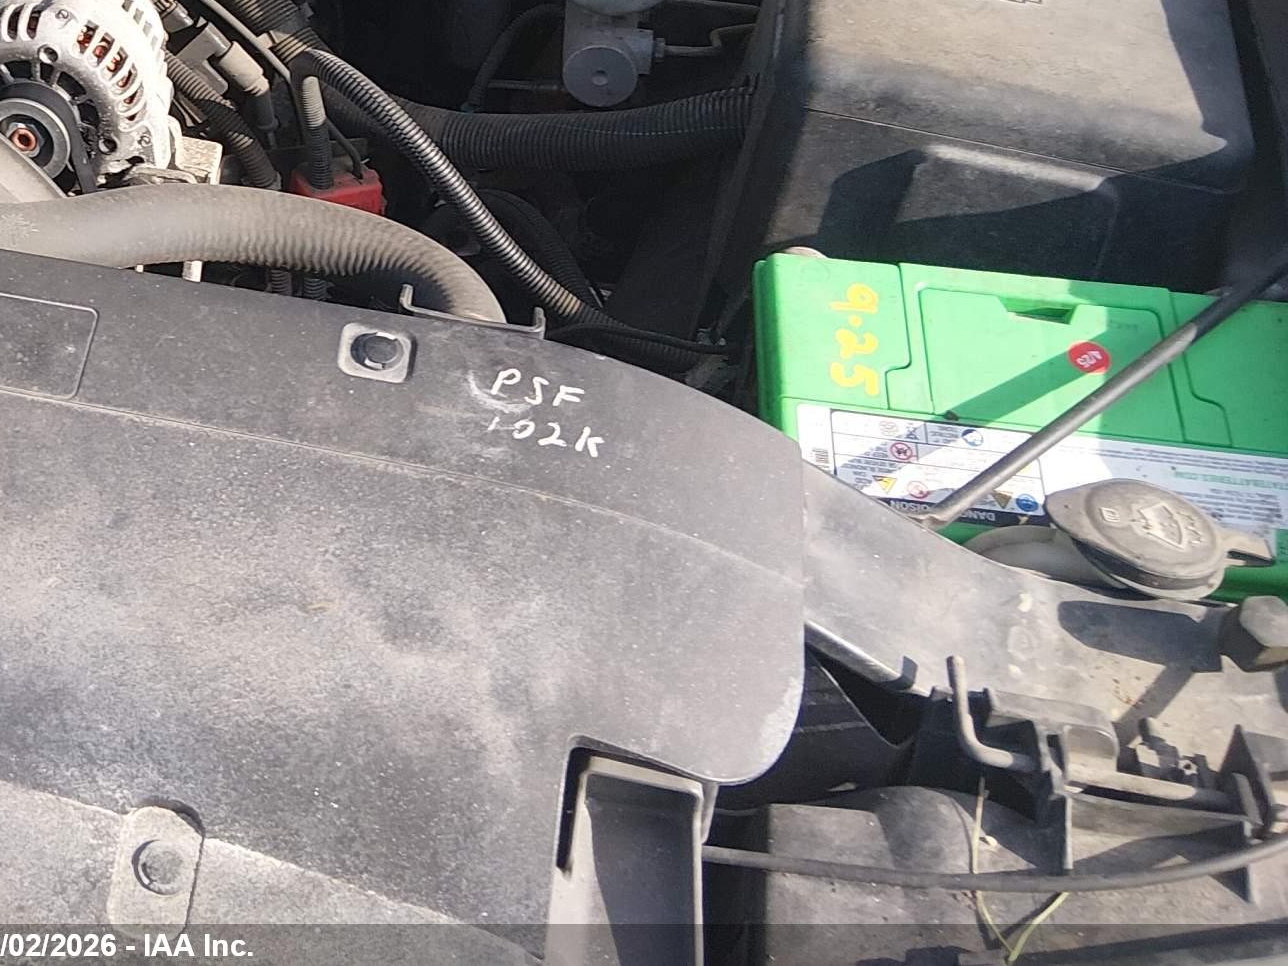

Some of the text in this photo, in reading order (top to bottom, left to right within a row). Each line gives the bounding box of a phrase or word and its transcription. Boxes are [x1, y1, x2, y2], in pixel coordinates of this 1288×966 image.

[829, 282, 879, 396] 9.25
[491, 368, 585, 406] PSF
[487, 416, 605, 458] 102K
[889, 499, 930, 514] OISON
